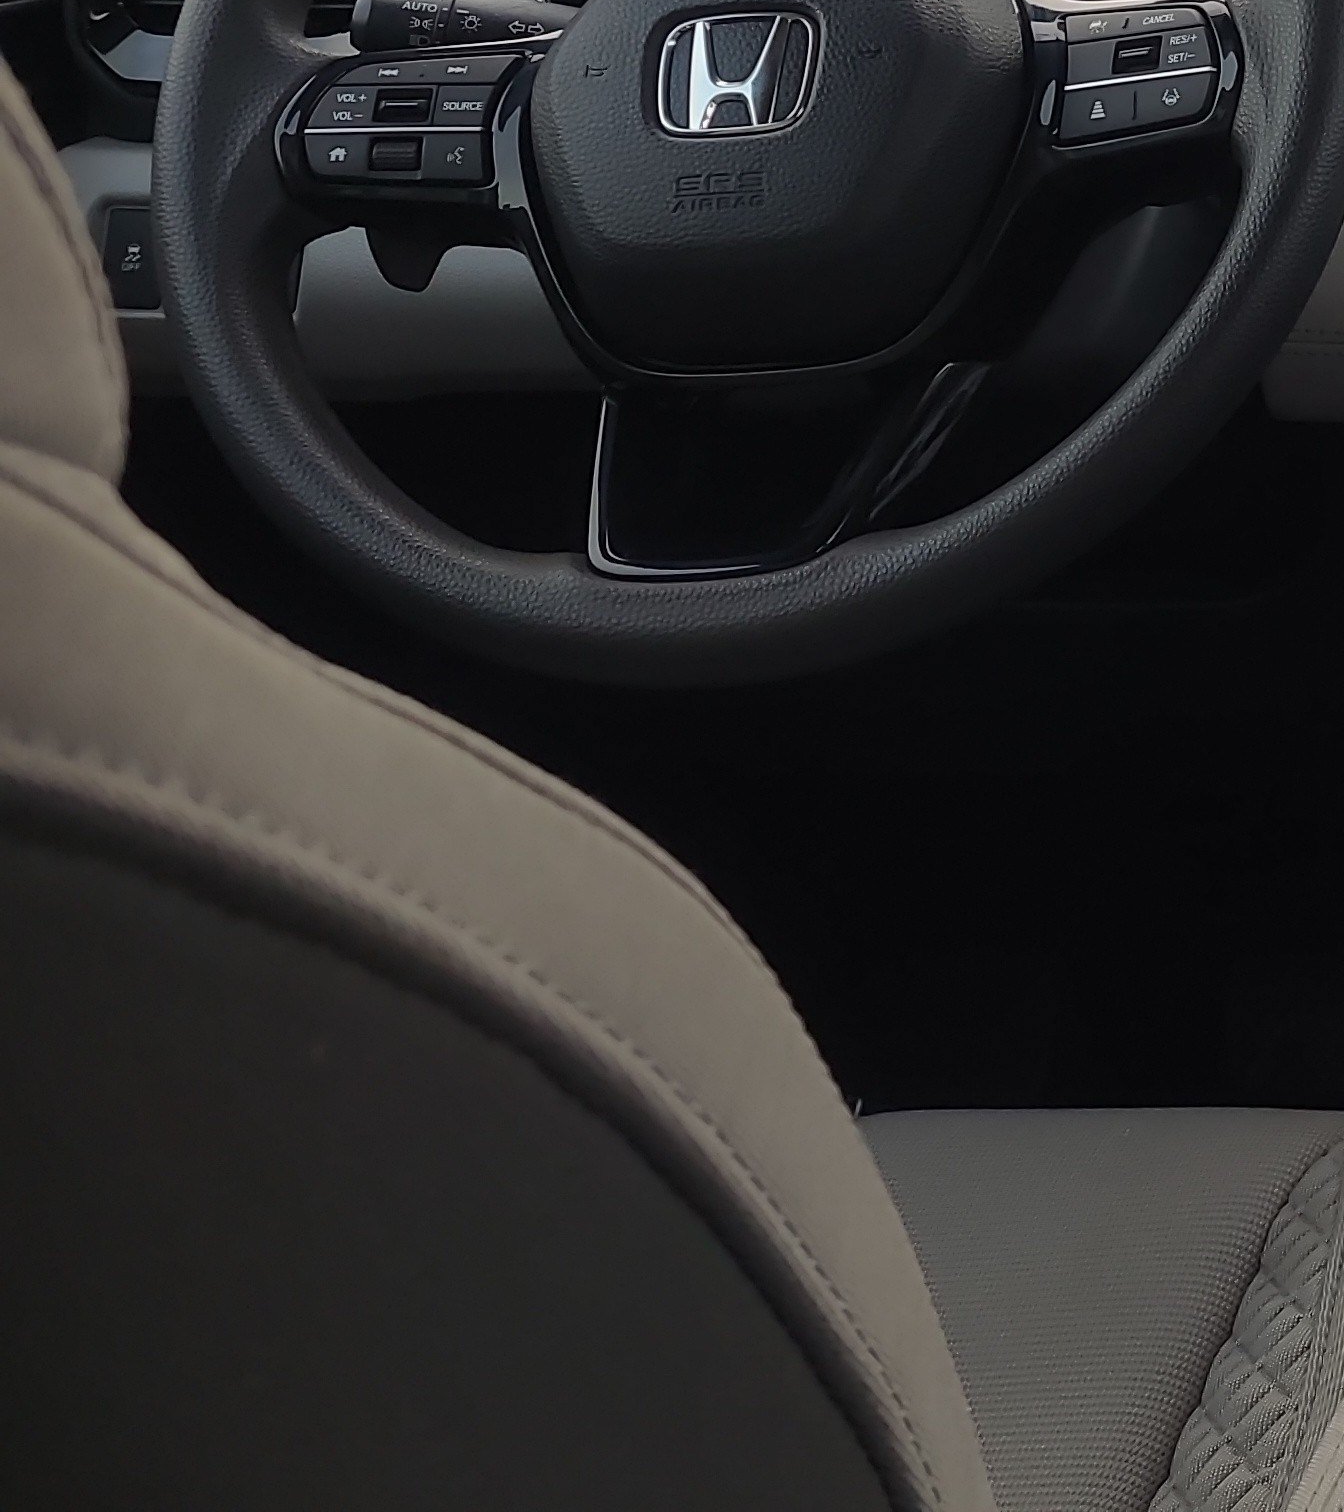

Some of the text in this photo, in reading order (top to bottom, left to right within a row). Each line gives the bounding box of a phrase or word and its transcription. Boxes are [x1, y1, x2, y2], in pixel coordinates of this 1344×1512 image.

[401, 0, 438, 13] AUTO
[1142, 14, 1176, 26] CANCEL
[442, 101, 485, 111] SOURCE
